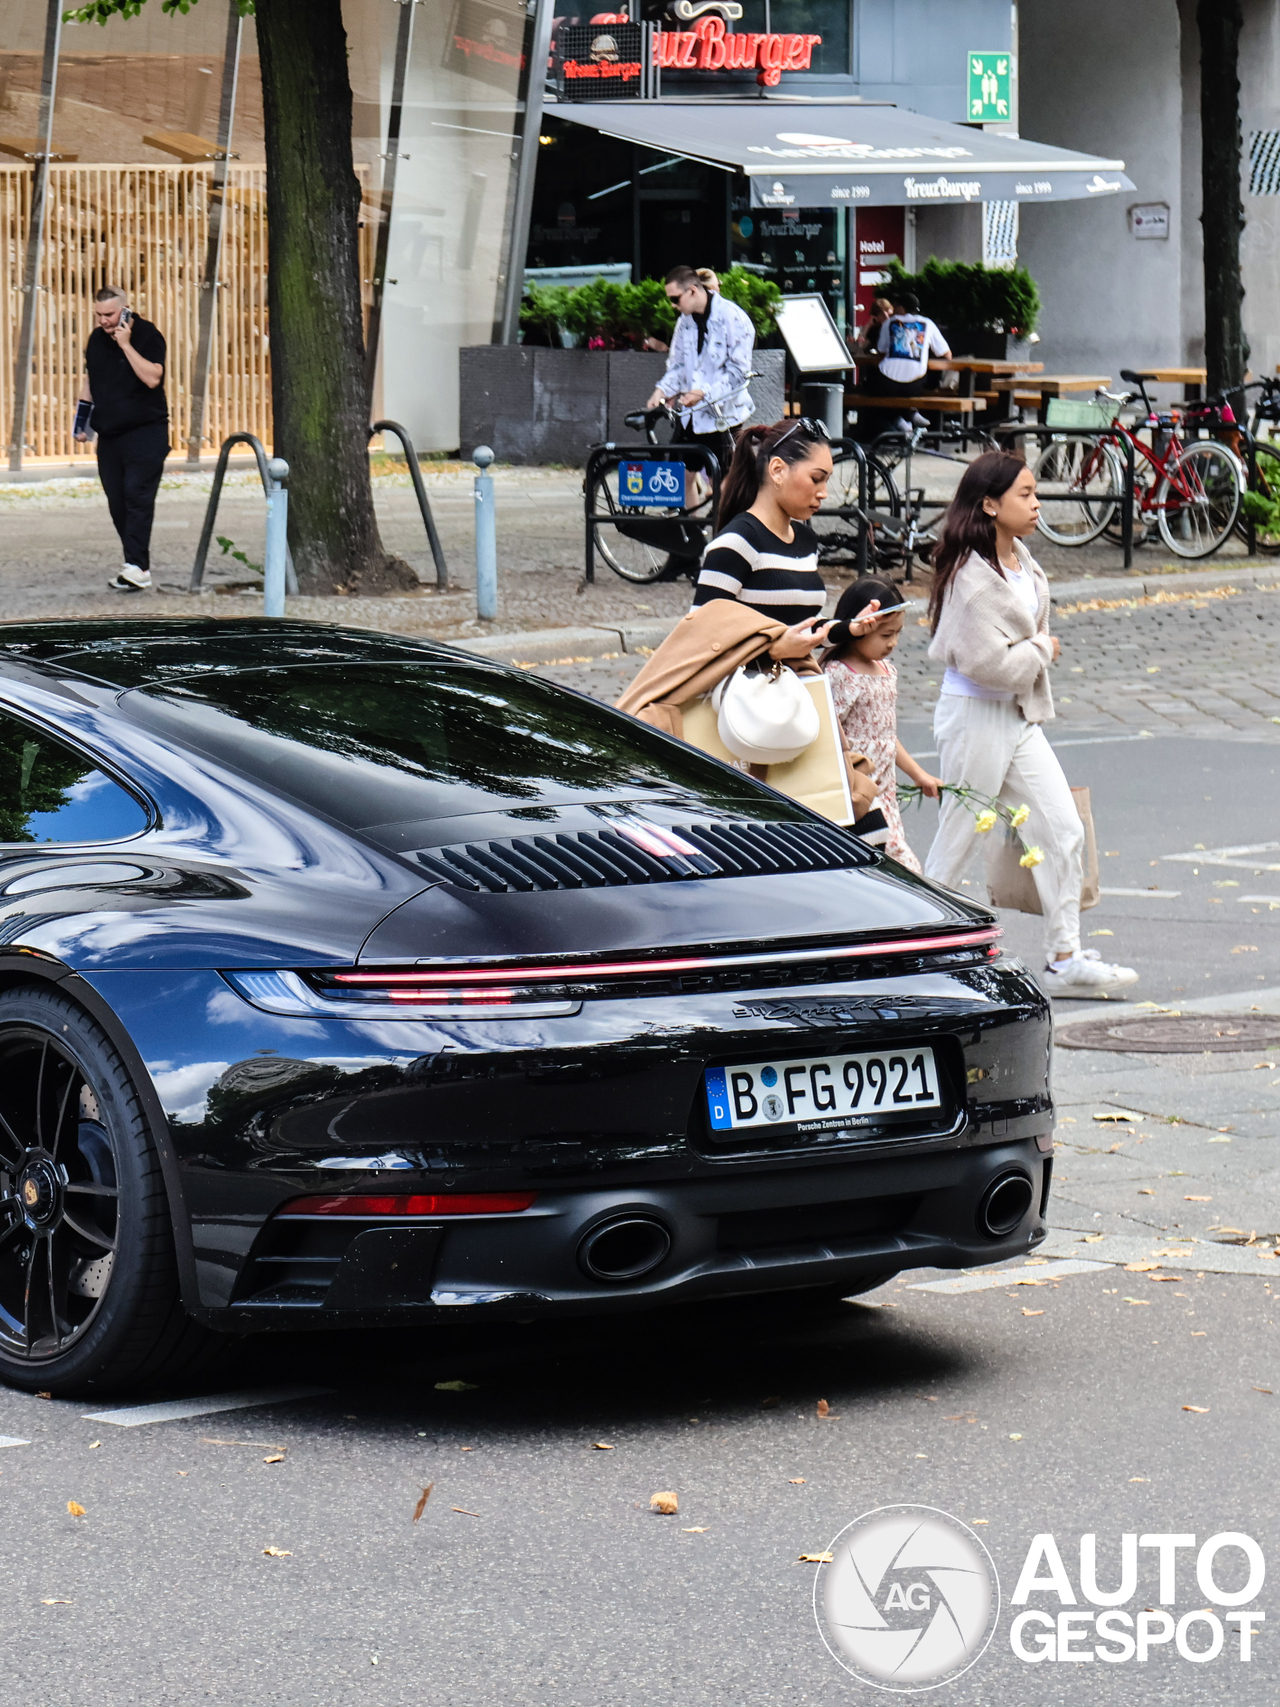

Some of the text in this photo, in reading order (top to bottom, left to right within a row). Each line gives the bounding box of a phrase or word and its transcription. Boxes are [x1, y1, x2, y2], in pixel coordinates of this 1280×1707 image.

[831, 185, 870, 199] since 1999
[903, 176, 981, 202] KreuzBurger
[1033, 181, 1052, 194] 1999
[859, 239, 886, 253] Hotel
[732, 995, 917, 1020] 911 Carrera 4 GTS
[730, 1054, 935, 1120] B FG 9921
[714, 1105, 725, 1120] D
[797, 1116, 869, 1131] Porsche Zentren in Berlin
